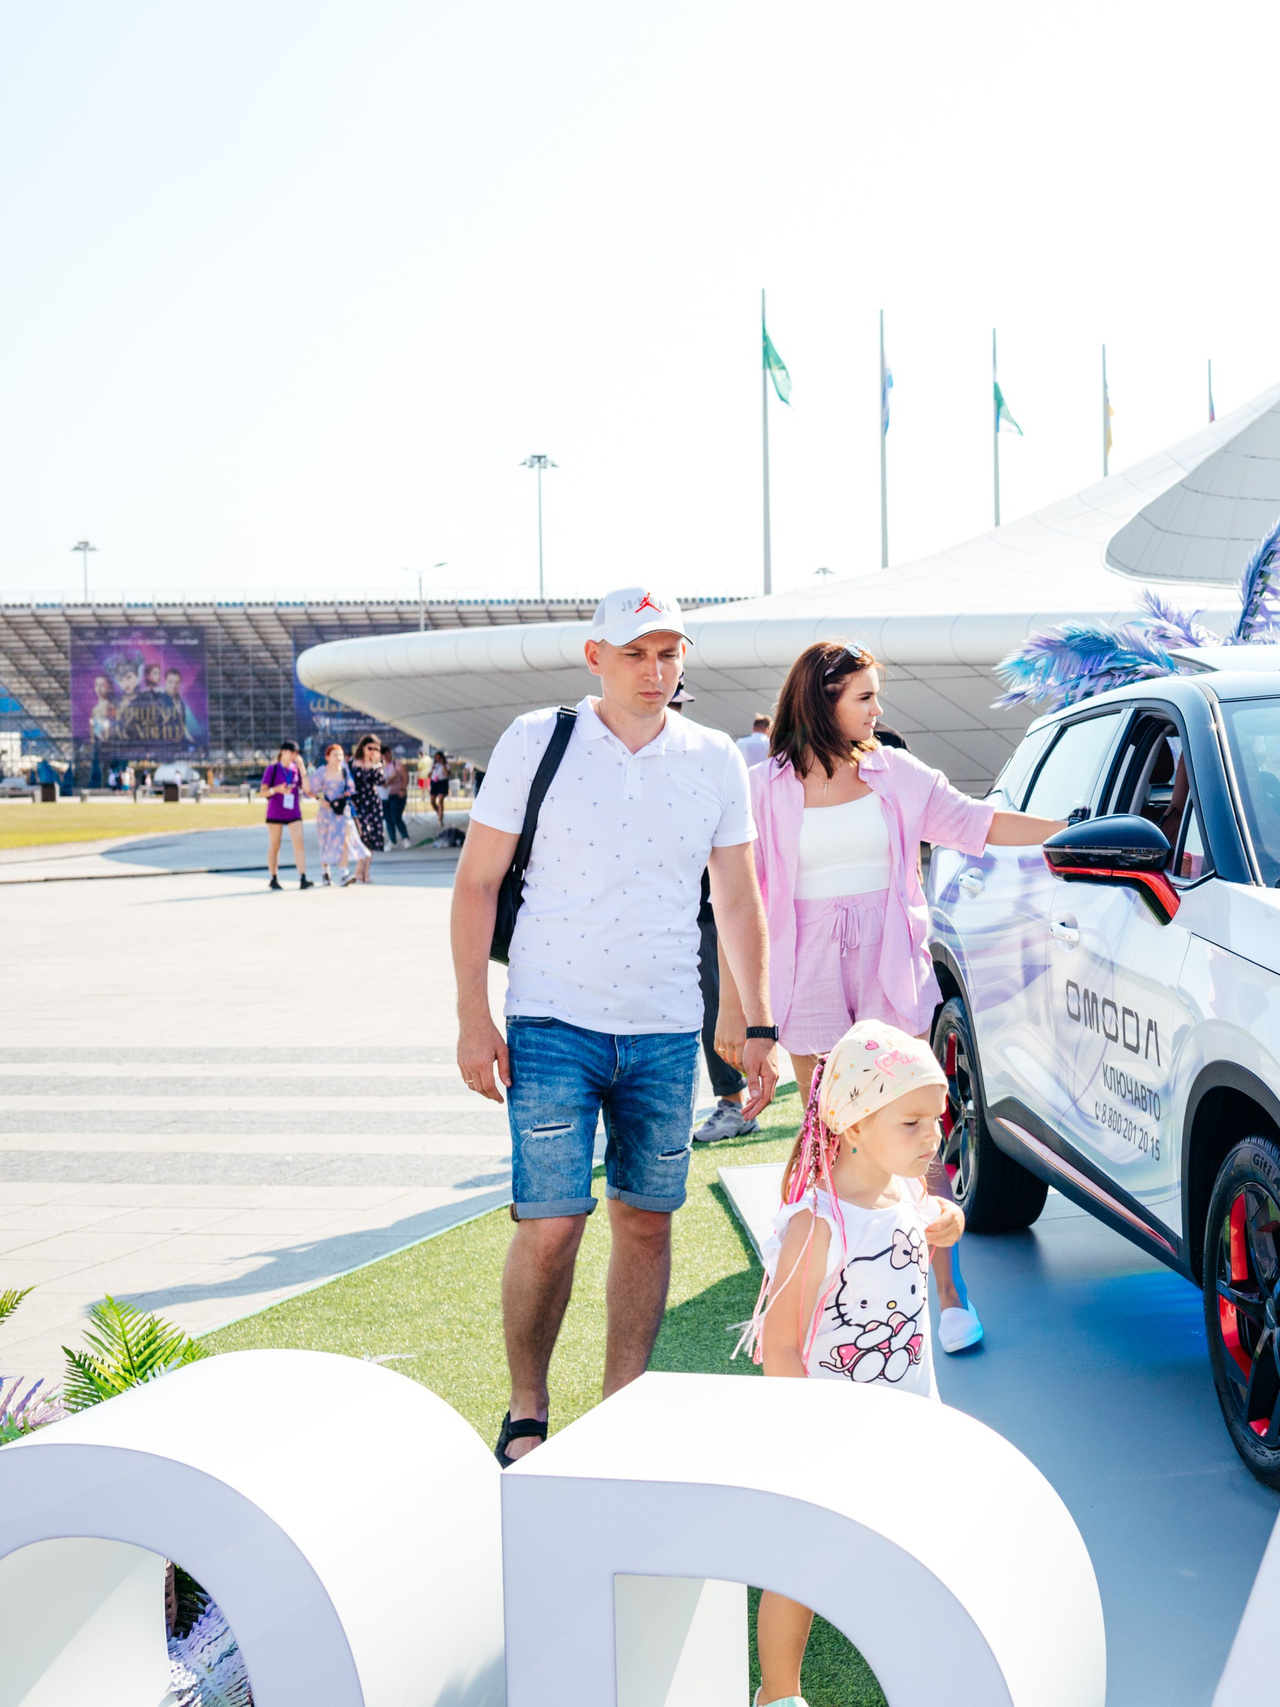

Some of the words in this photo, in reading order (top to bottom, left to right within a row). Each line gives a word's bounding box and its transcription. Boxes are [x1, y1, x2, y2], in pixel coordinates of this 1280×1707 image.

[1065, 979, 1161, 1067] OMODA
[1102, 1062, 1161, 1121] КЛЮЧАВТО
[1101, 1103, 1107, 1124] 8
[1108, 1107, 1122, 1134] 800
[1123, 1117, 1137, 1145] 201
[1138, 1128, 1149, 1153] 20
[1150, 1136, 1160, 1161] 15
[1252, 1153, 1272, 1177] Giti
